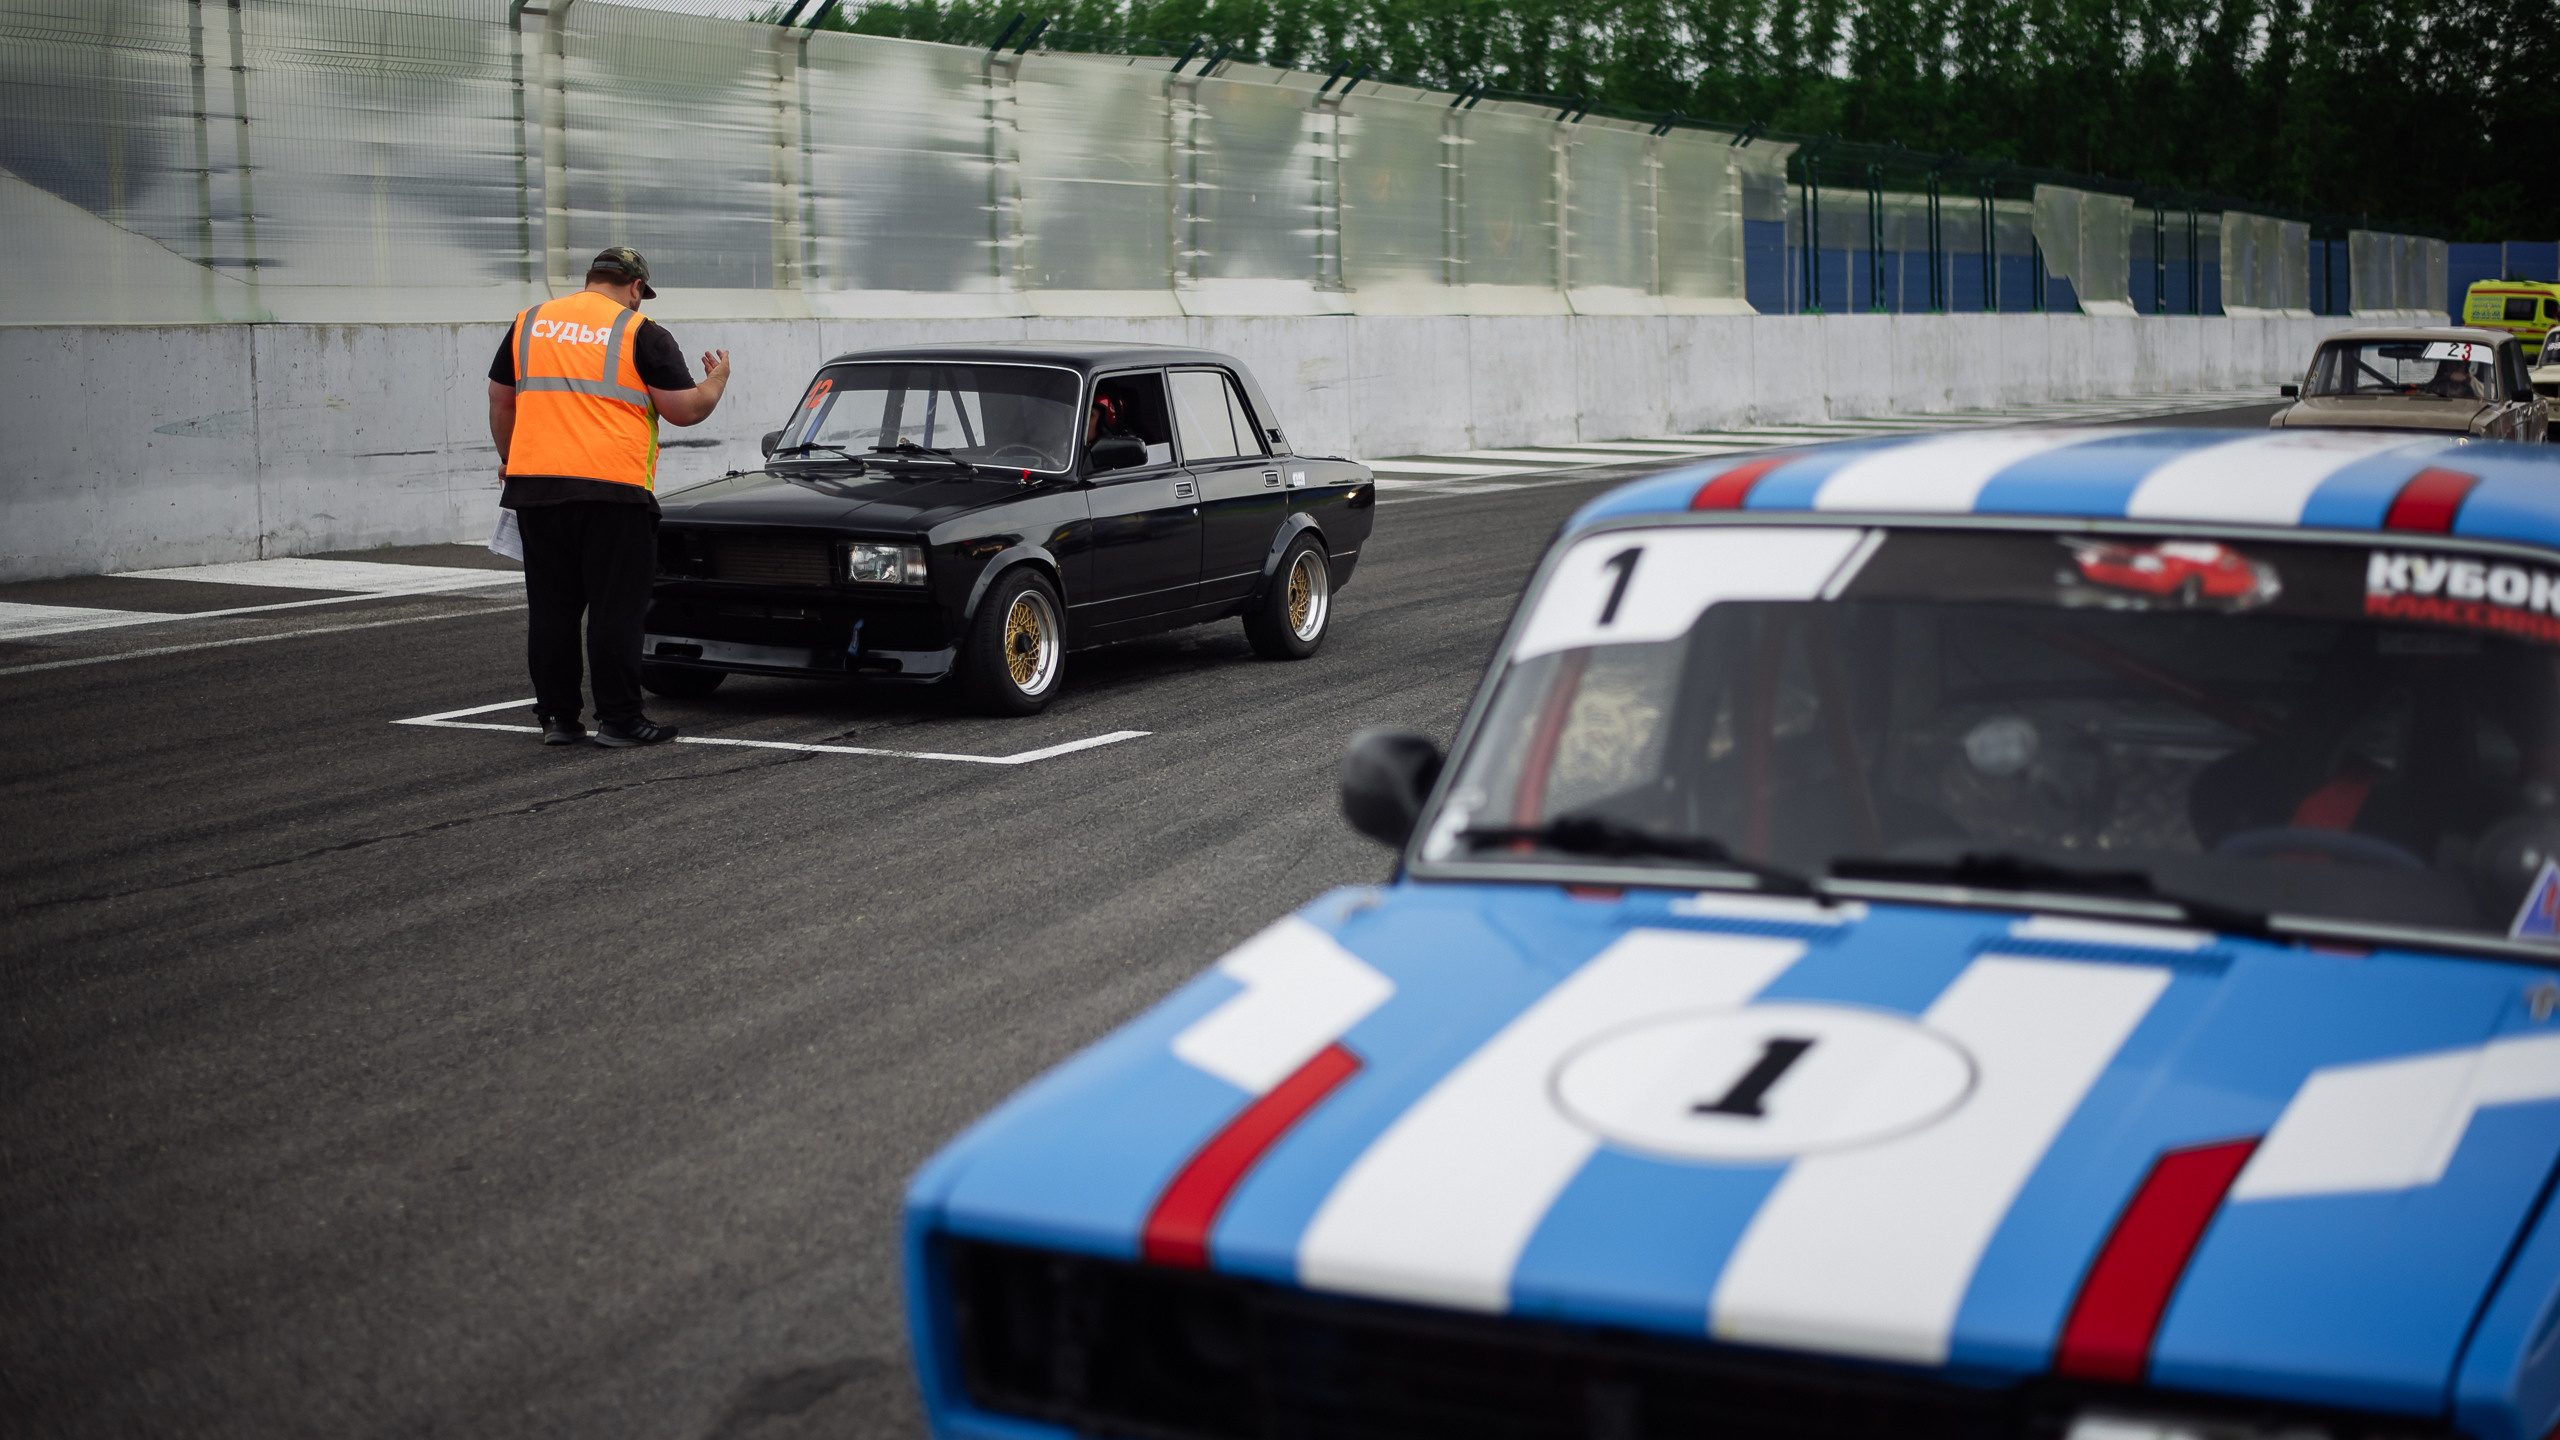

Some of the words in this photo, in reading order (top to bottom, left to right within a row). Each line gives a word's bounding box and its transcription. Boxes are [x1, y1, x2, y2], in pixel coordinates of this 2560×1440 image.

[531, 319, 612, 346] СУДЬЯ
[2447, 342, 2472, 361] 23
[804, 379, 834, 410] 12
[1600, 546, 1645, 625] 1
[2366, 551, 2560, 618] КУБОК
[1690, 1036, 1818, 1118] 1
